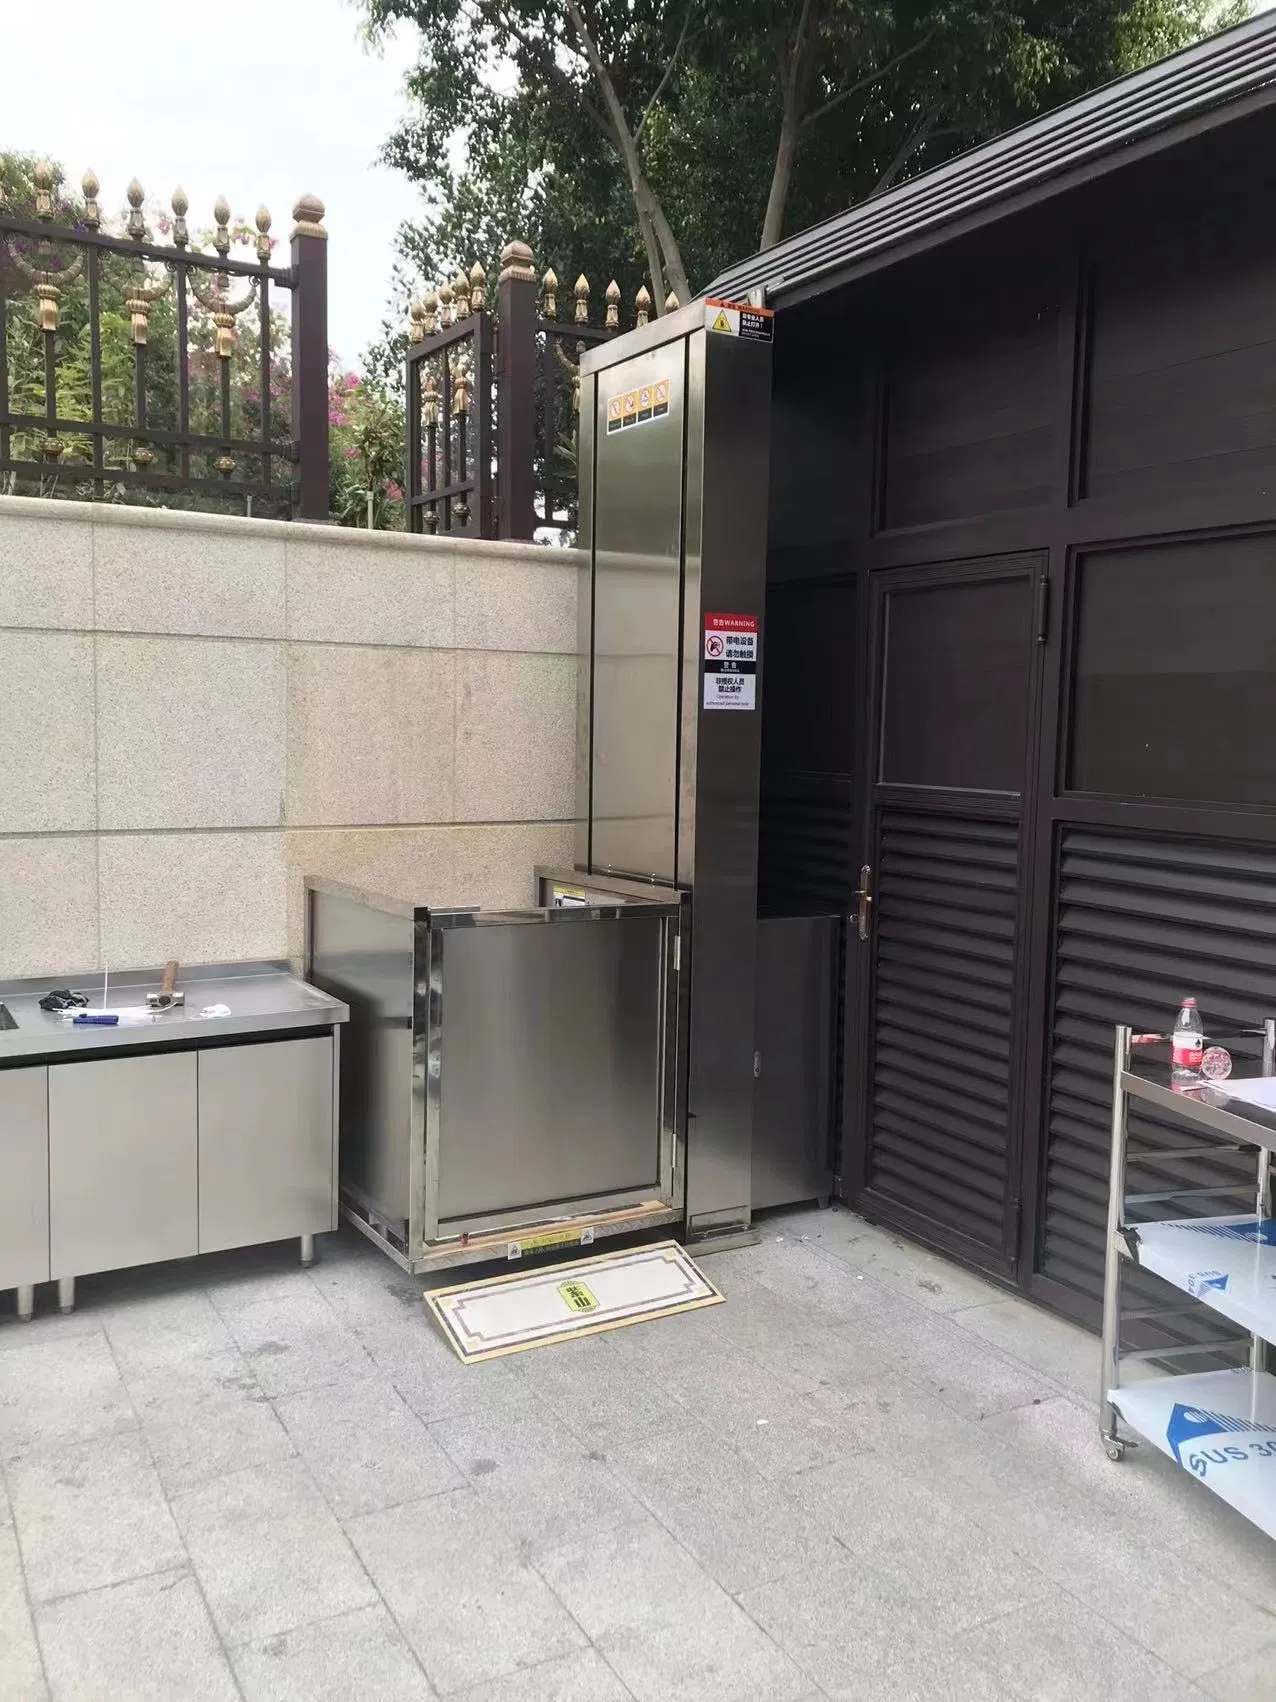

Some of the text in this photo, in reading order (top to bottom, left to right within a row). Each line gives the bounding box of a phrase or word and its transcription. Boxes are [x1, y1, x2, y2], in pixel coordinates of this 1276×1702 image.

[726, 636, 754, 646] 带电设备
[725, 649, 754, 659] 请勿触摸
[715, 677, 745, 685] 非授权人员
[718, 685, 742, 693] 禁止操作
[1189, 1446, 1249, 1477] SUS
